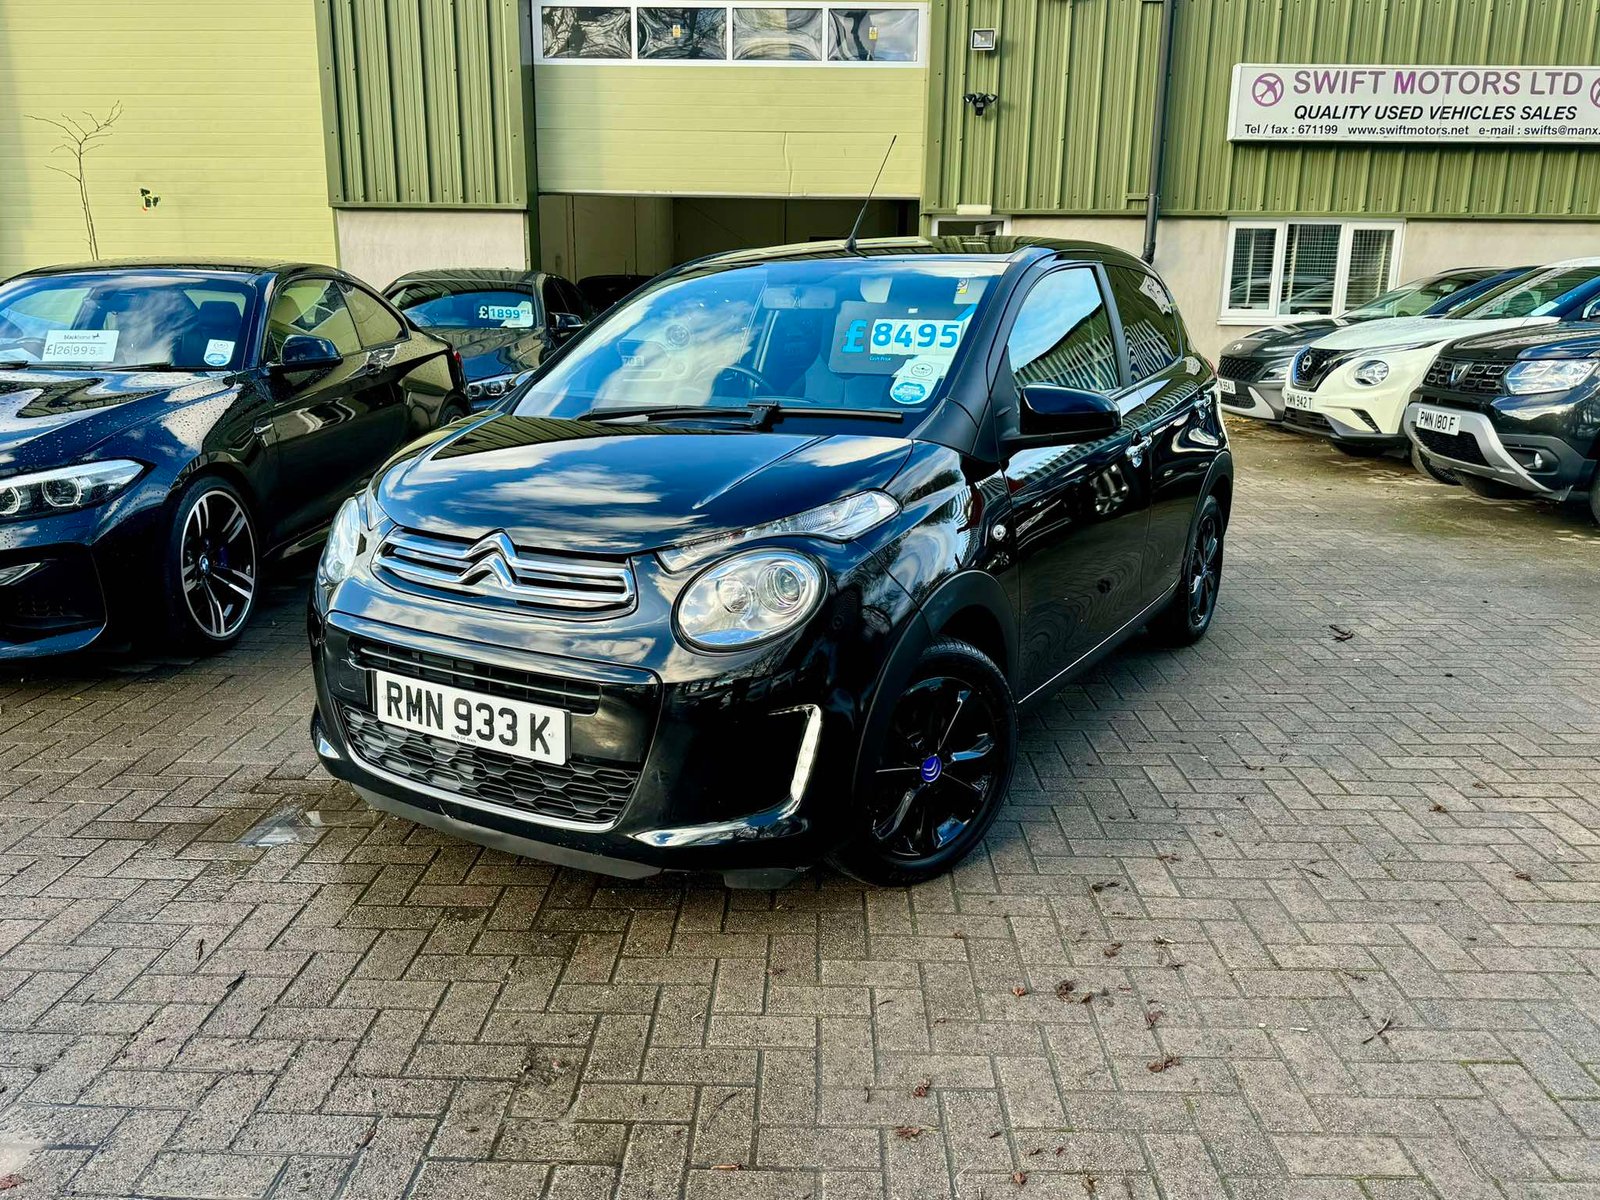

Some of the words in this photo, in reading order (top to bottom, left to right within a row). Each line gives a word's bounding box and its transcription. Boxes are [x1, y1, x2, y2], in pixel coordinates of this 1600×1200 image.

[1293, 70, 1386, 94] SWIFT
[1393, 71, 1521, 95] MOTORS
[1530, 72, 1583, 96] LTD
[1294, 105, 1369, 121] QUALITY
[1375, 106, 1423, 120] USED
[1429, 106, 1515, 120] VEHICLES
[1520, 106, 1577, 120] SALES
[1244, 124, 1260, 134] Tel
[1271, 124, 1288, 134] fax
[1297, 124, 1338, 134] 671199
[1347, 124, 1469, 135] www.swiftmotors.net
[1478, 125, 1514, 135] e-mail
[842, 319, 960, 353] £8495
[1308, 397, 1312, 409] T
[1420, 411, 1434, 427] PMN
[1434, 413, 1447, 430] 180
[1448, 417, 1456, 431] F
[386, 680, 444, 730] RMN
[454, 698, 518, 747] 933
[529, 713, 551, 755] K
